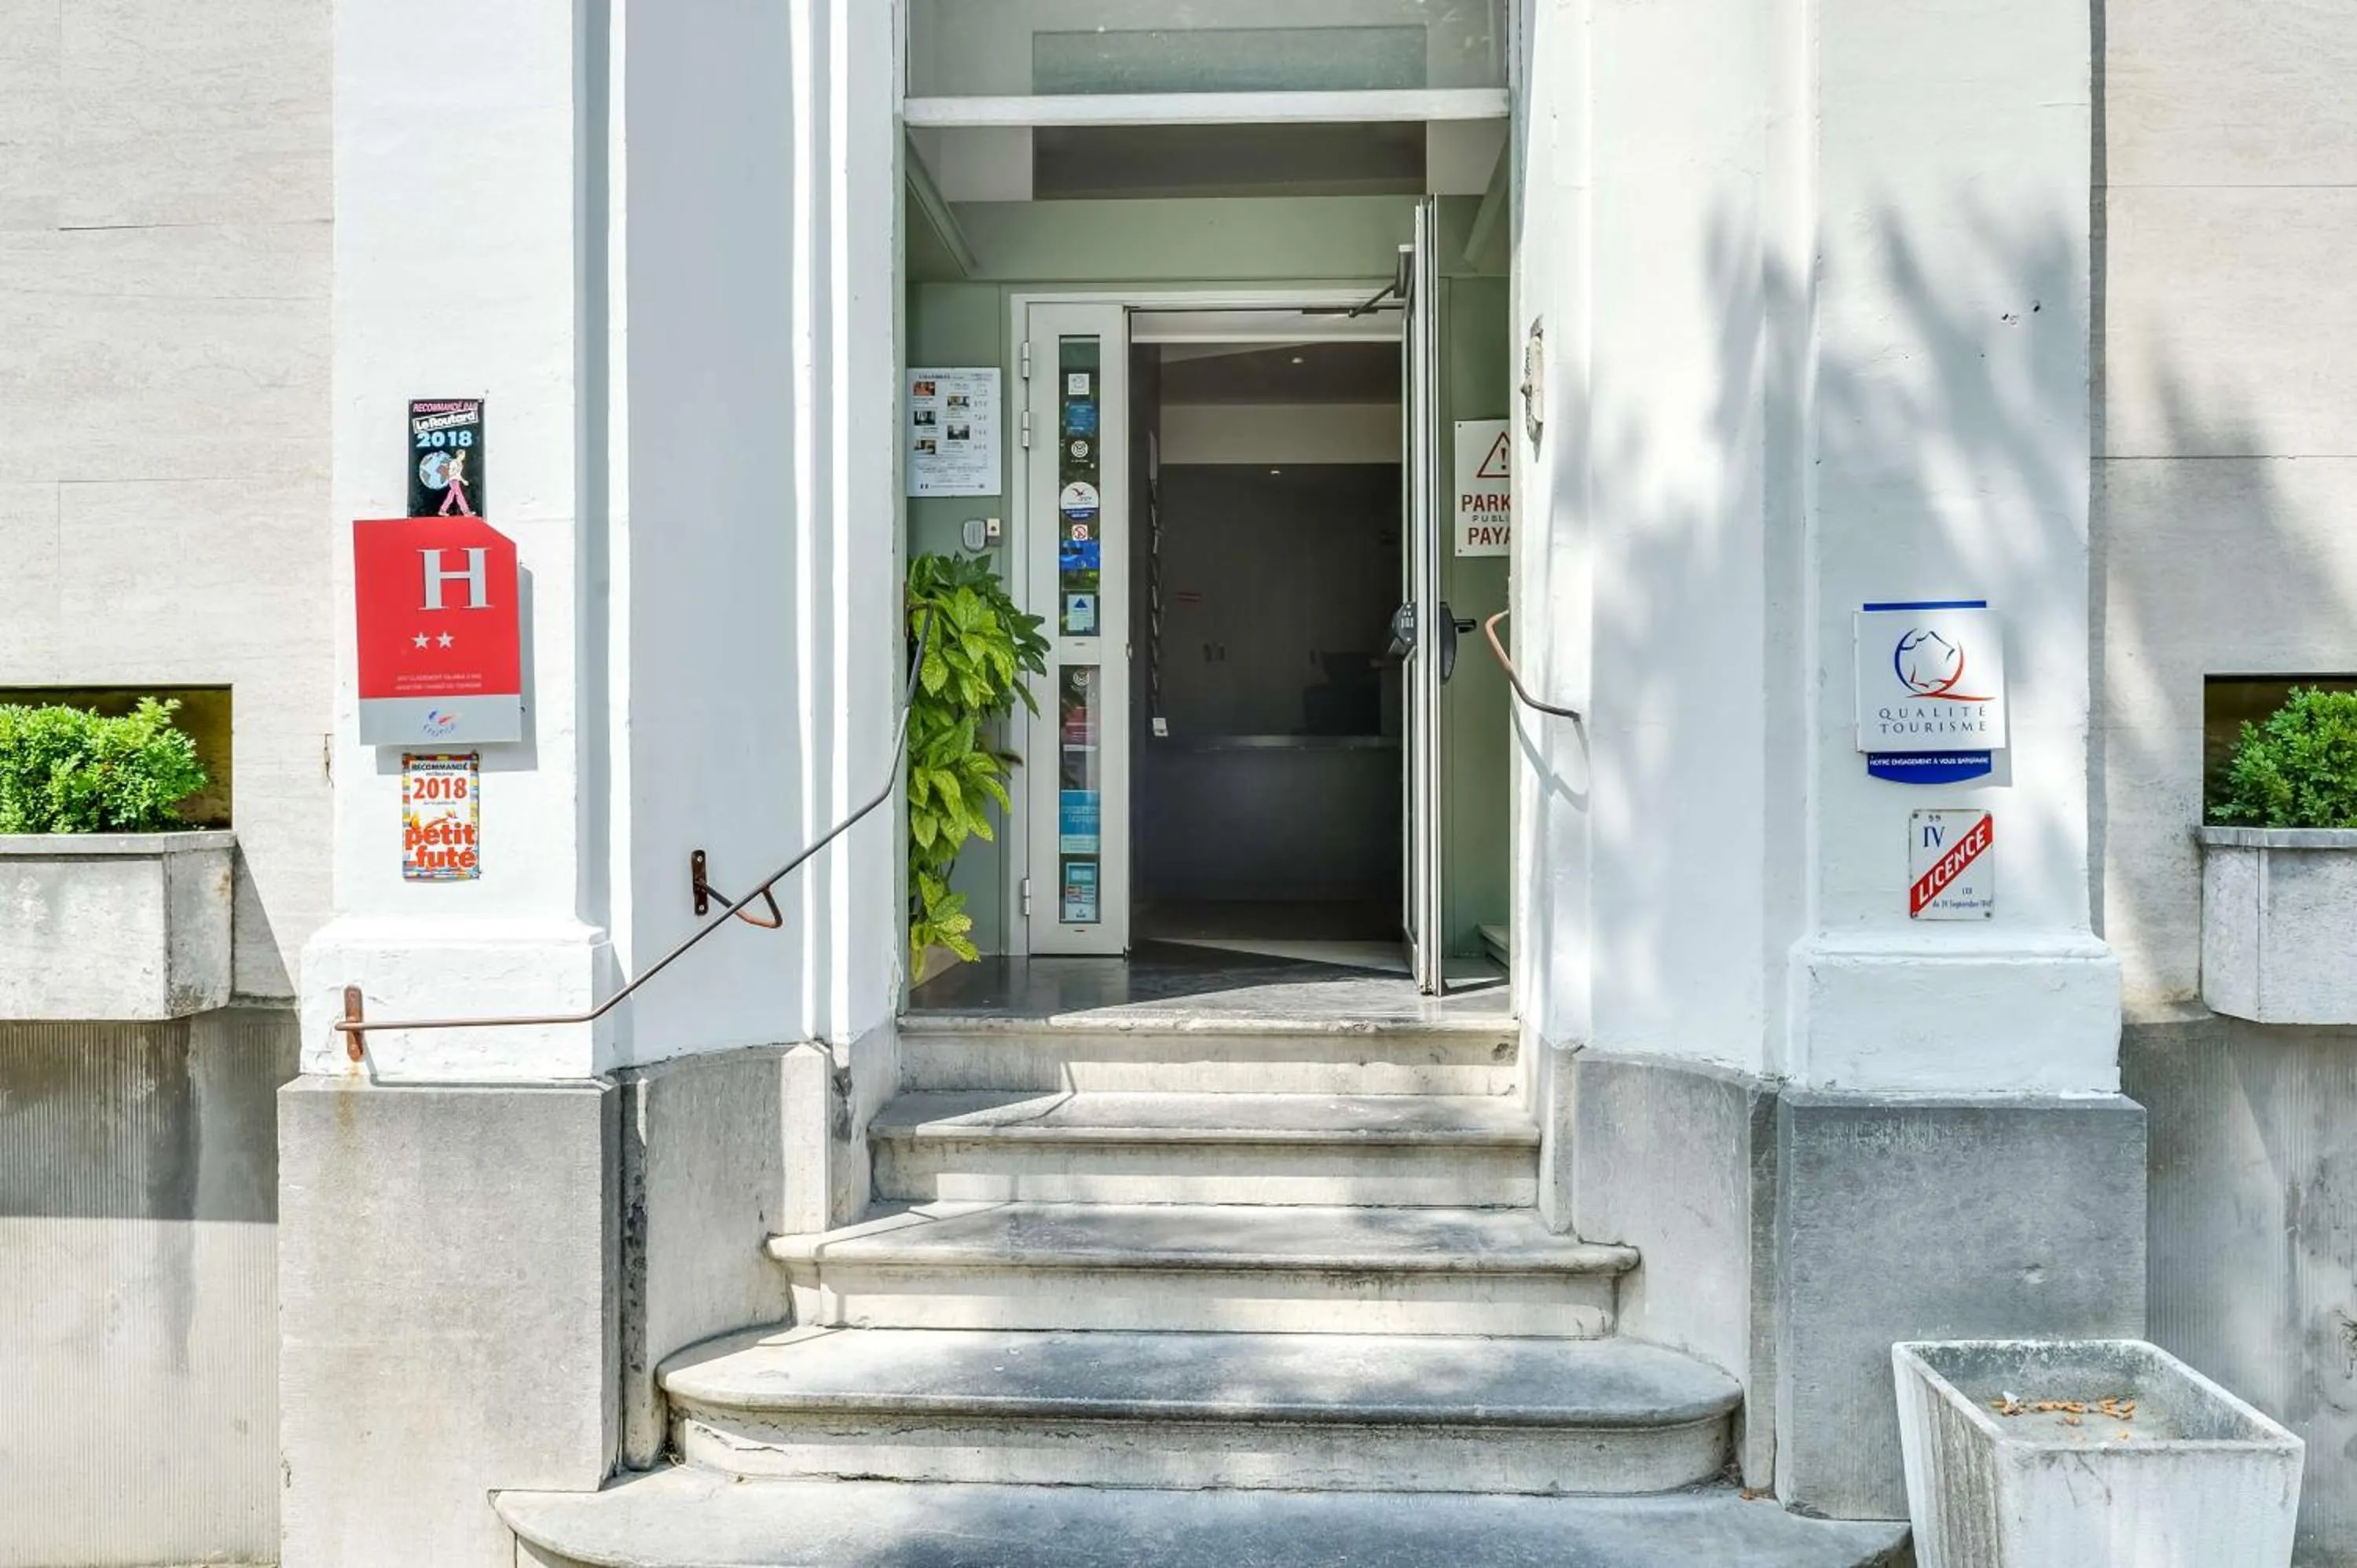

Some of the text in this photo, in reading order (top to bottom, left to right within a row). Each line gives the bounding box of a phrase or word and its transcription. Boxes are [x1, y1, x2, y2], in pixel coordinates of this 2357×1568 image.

[416, 430, 473, 447] 2018
[416, 547, 496, 610] H
[1879, 704, 1987, 721] QUALITÉ
[1879, 720, 1987, 735] TOURISME
[412, 762, 468, 771] RECOMMANDÉ
[1869, 757, 1890, 766] NOTRE
[1891, 757, 1932, 766] ENGAGEMENT
[413, 777, 467, 799] 2018
[405, 822, 475, 850] petit
[1923, 826, 1945, 848] IV
[415, 845, 476, 868] futé
[1919, 825, 1985, 906] LICENCE
